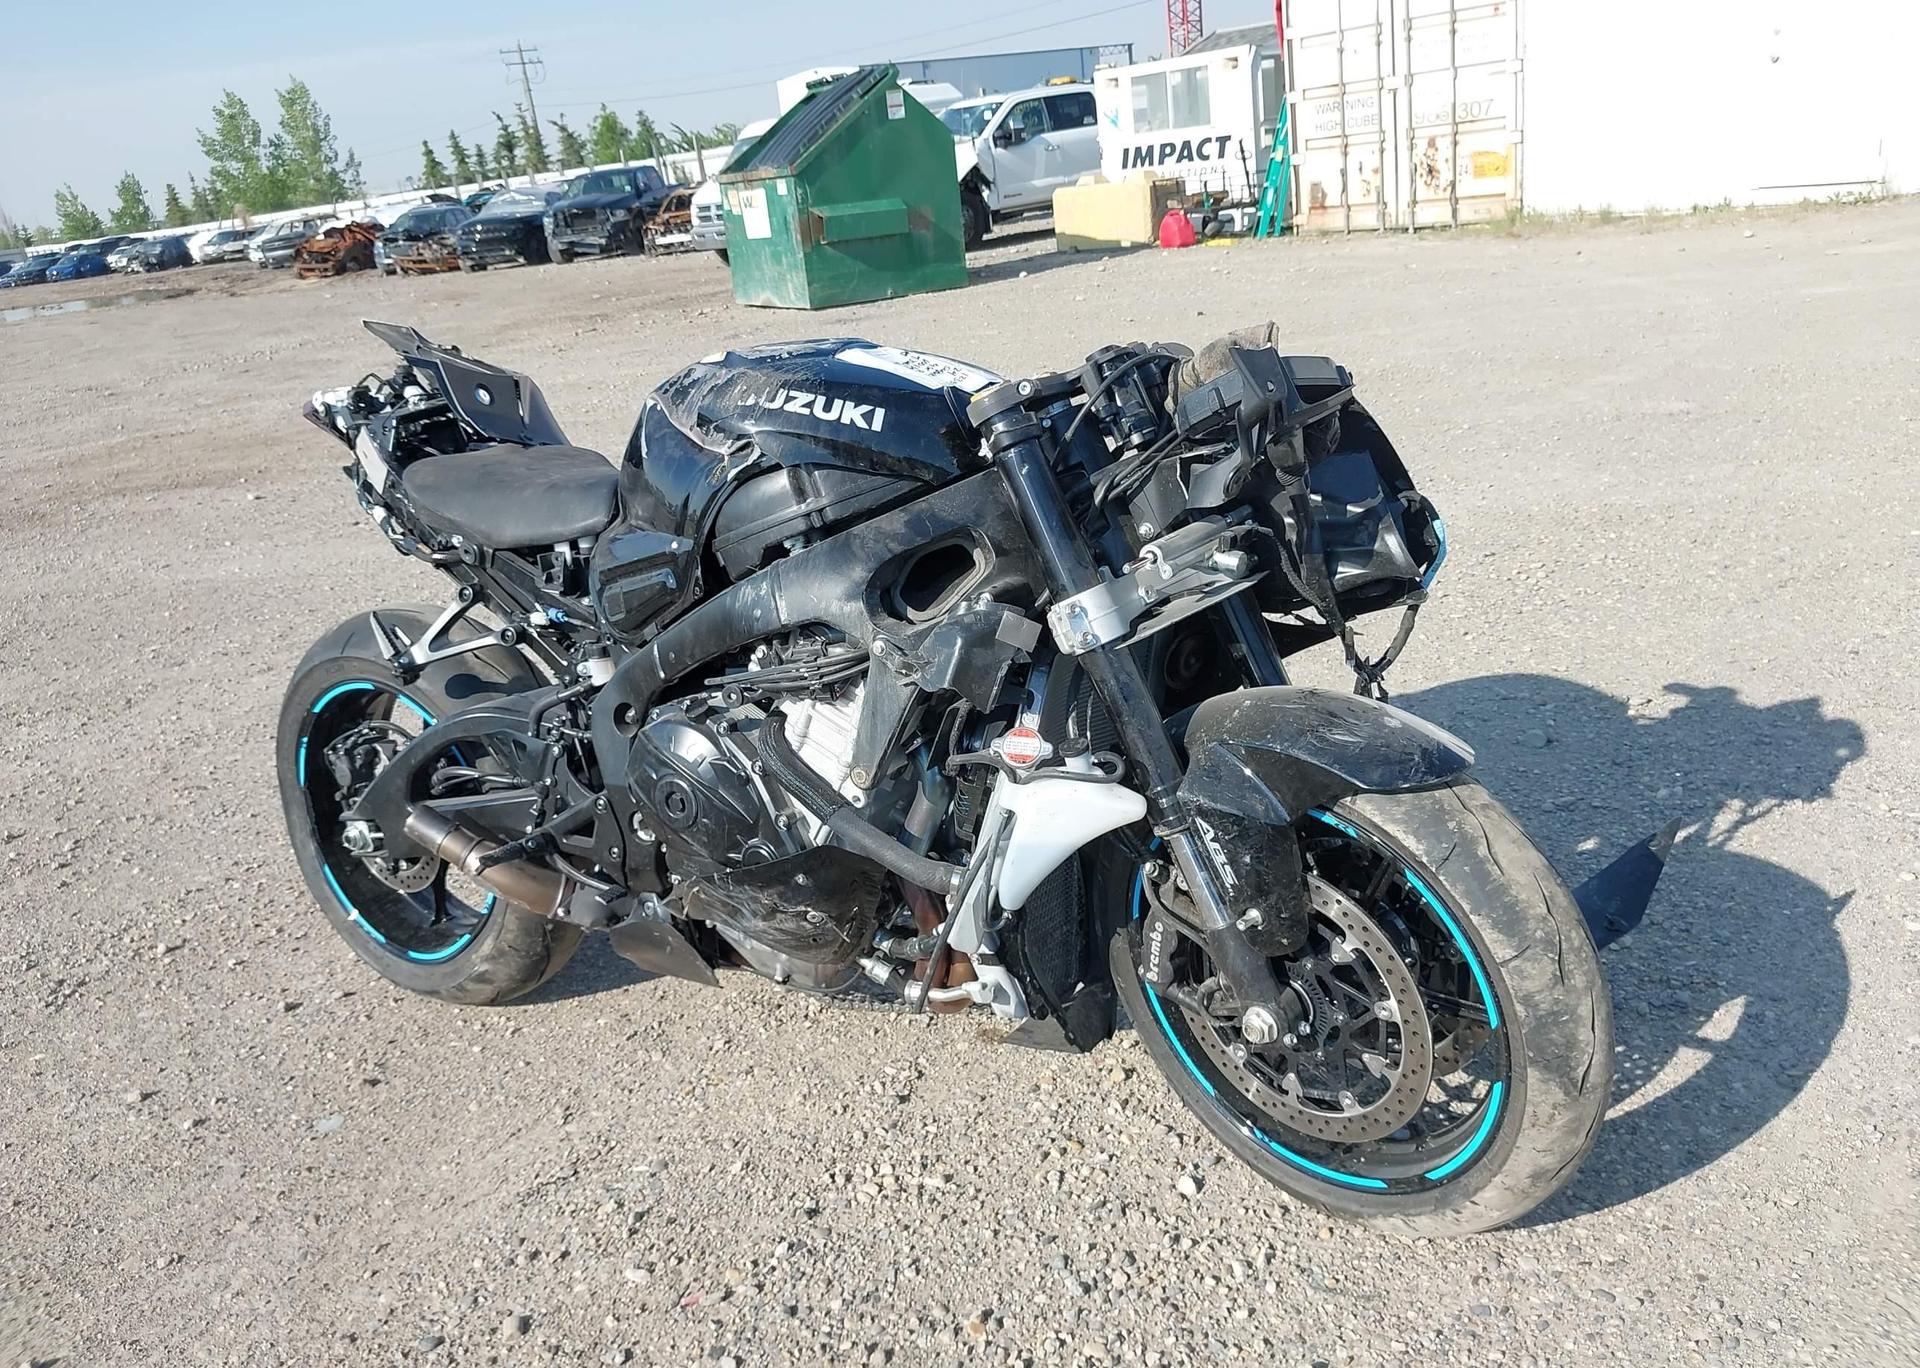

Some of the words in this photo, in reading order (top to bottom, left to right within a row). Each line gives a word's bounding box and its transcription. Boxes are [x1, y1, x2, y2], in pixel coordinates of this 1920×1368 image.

[1315, 96, 1375, 115] WARNING
[1458, 99, 1494, 120] 307
[1315, 119, 1343, 133] HIGH
[1347, 113, 1379, 129] CUBE
[1122, 135, 1232, 170] IMPACT
[1194, 816, 1240, 892] ABS
[1145, 921, 1164, 982] brembo
